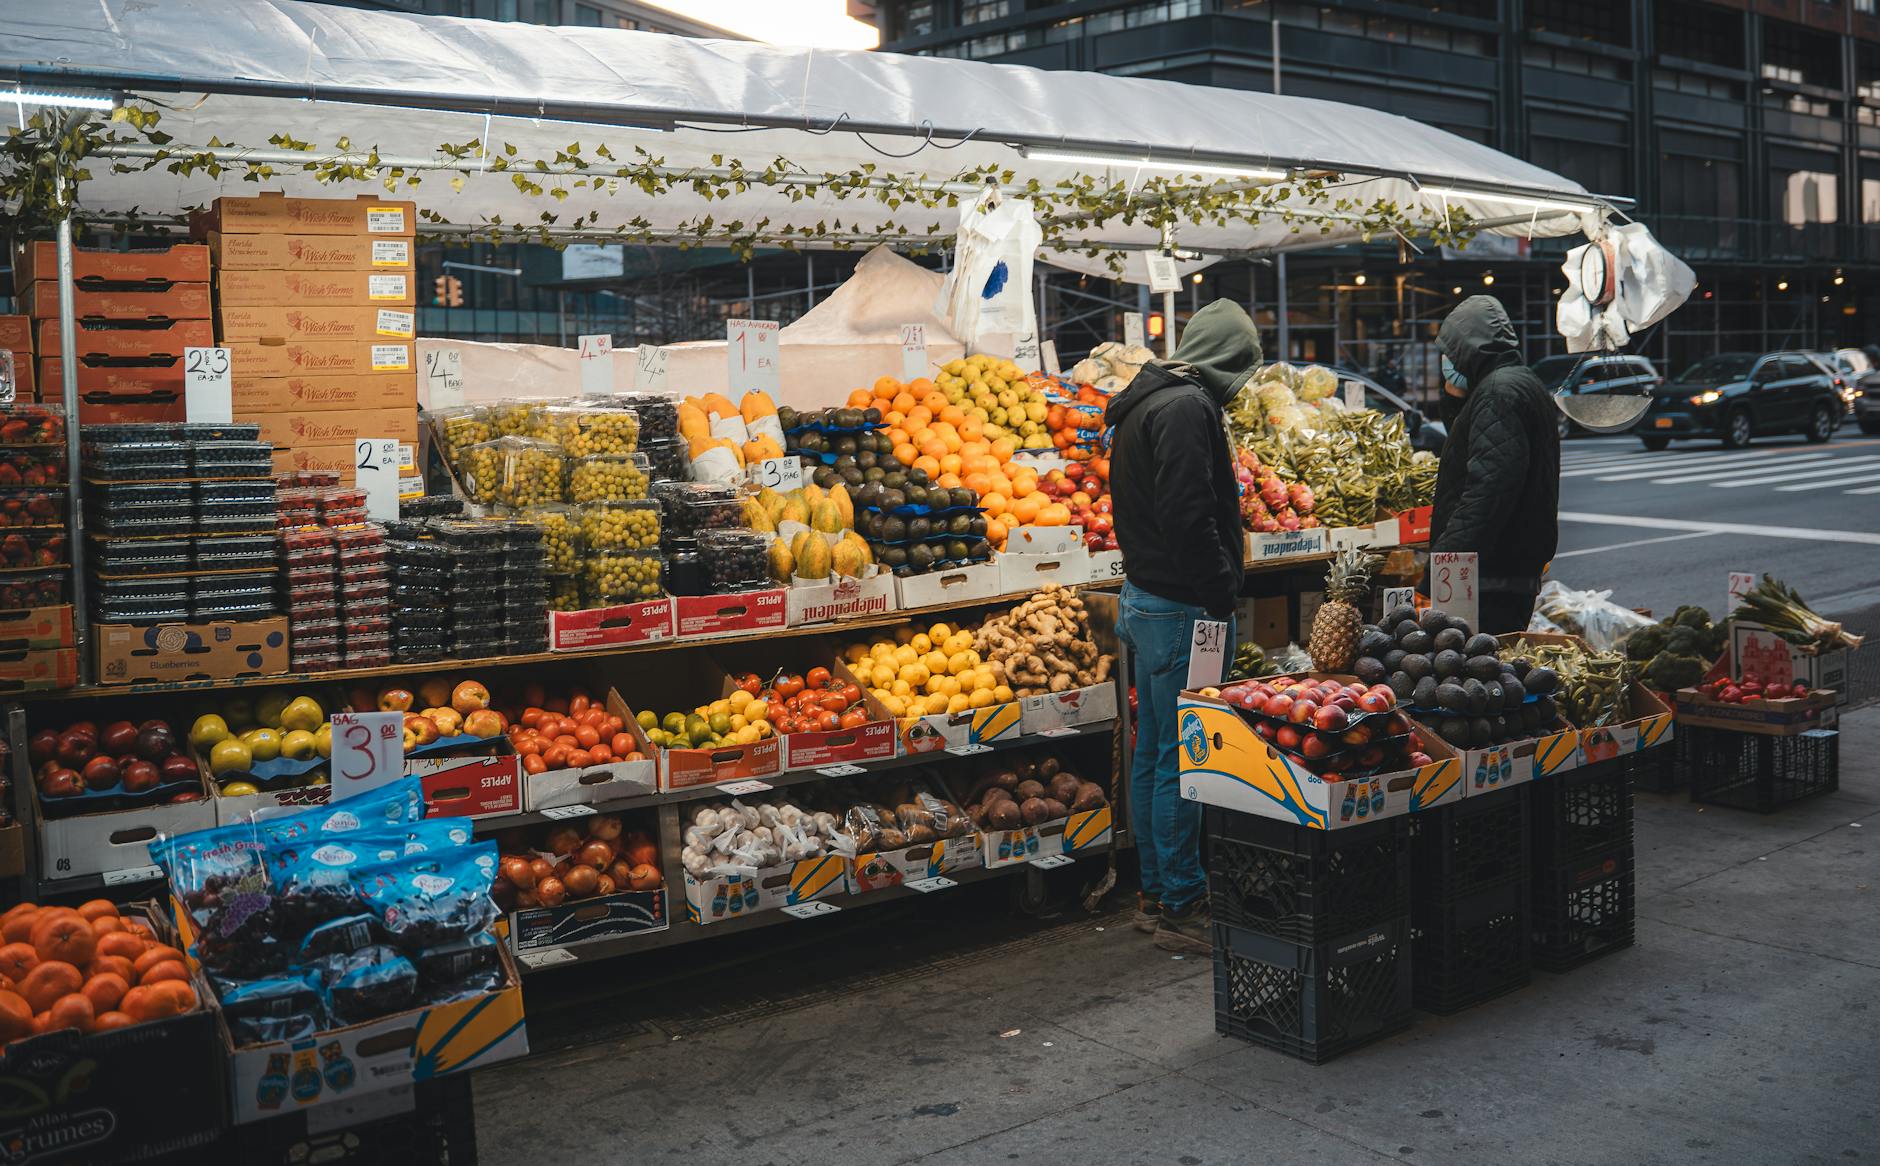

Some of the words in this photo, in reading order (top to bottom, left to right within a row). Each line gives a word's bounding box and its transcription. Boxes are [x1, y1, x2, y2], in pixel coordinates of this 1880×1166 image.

[303, 210, 328, 223] Wish
[328, 209, 355, 223] Farms
[304, 250, 328, 261] Wish
[328, 249, 356, 261] Farms
[302, 284, 327, 296] Wish
[327, 283, 354, 295] Farms
[302, 321, 327, 332] Wish
[328, 320, 355, 332] Farms
[580, 339, 598, 360] 4
[736, 331, 746, 371] 1
[187, 350, 206, 373] 2
[212, 349, 228, 374] 3
[303, 356, 328, 367] Wish
[328, 354, 356, 366] Farms
[757, 358, 772, 368] EA
[304, 389, 329, 400] Wish
[329, 388, 357, 400] Farms
[306, 426, 331, 438] Wish
[331, 424, 358, 437] Farms
[357, 441, 379, 471] 2
[334, 460, 356, 471] Farm
[764, 460, 781, 487] 3
[1262, 536, 1321, 557] Independent
[1437, 567, 1453, 603] 3
[757, 595, 782, 606] APPLES
[642, 604, 668, 616] APPLES
[802, 594, 887, 622] Independent
[1194, 622, 1207, 646] 3
[1214, 622, 1220, 646] 1
[150, 660, 200, 669] Blueberries
[332, 713, 359, 725] BAG
[865, 725, 890, 736] APPLES
[341, 725, 376, 780] 3
[753, 742, 777, 756] APPLES
[481, 774, 512, 788] APPLES
